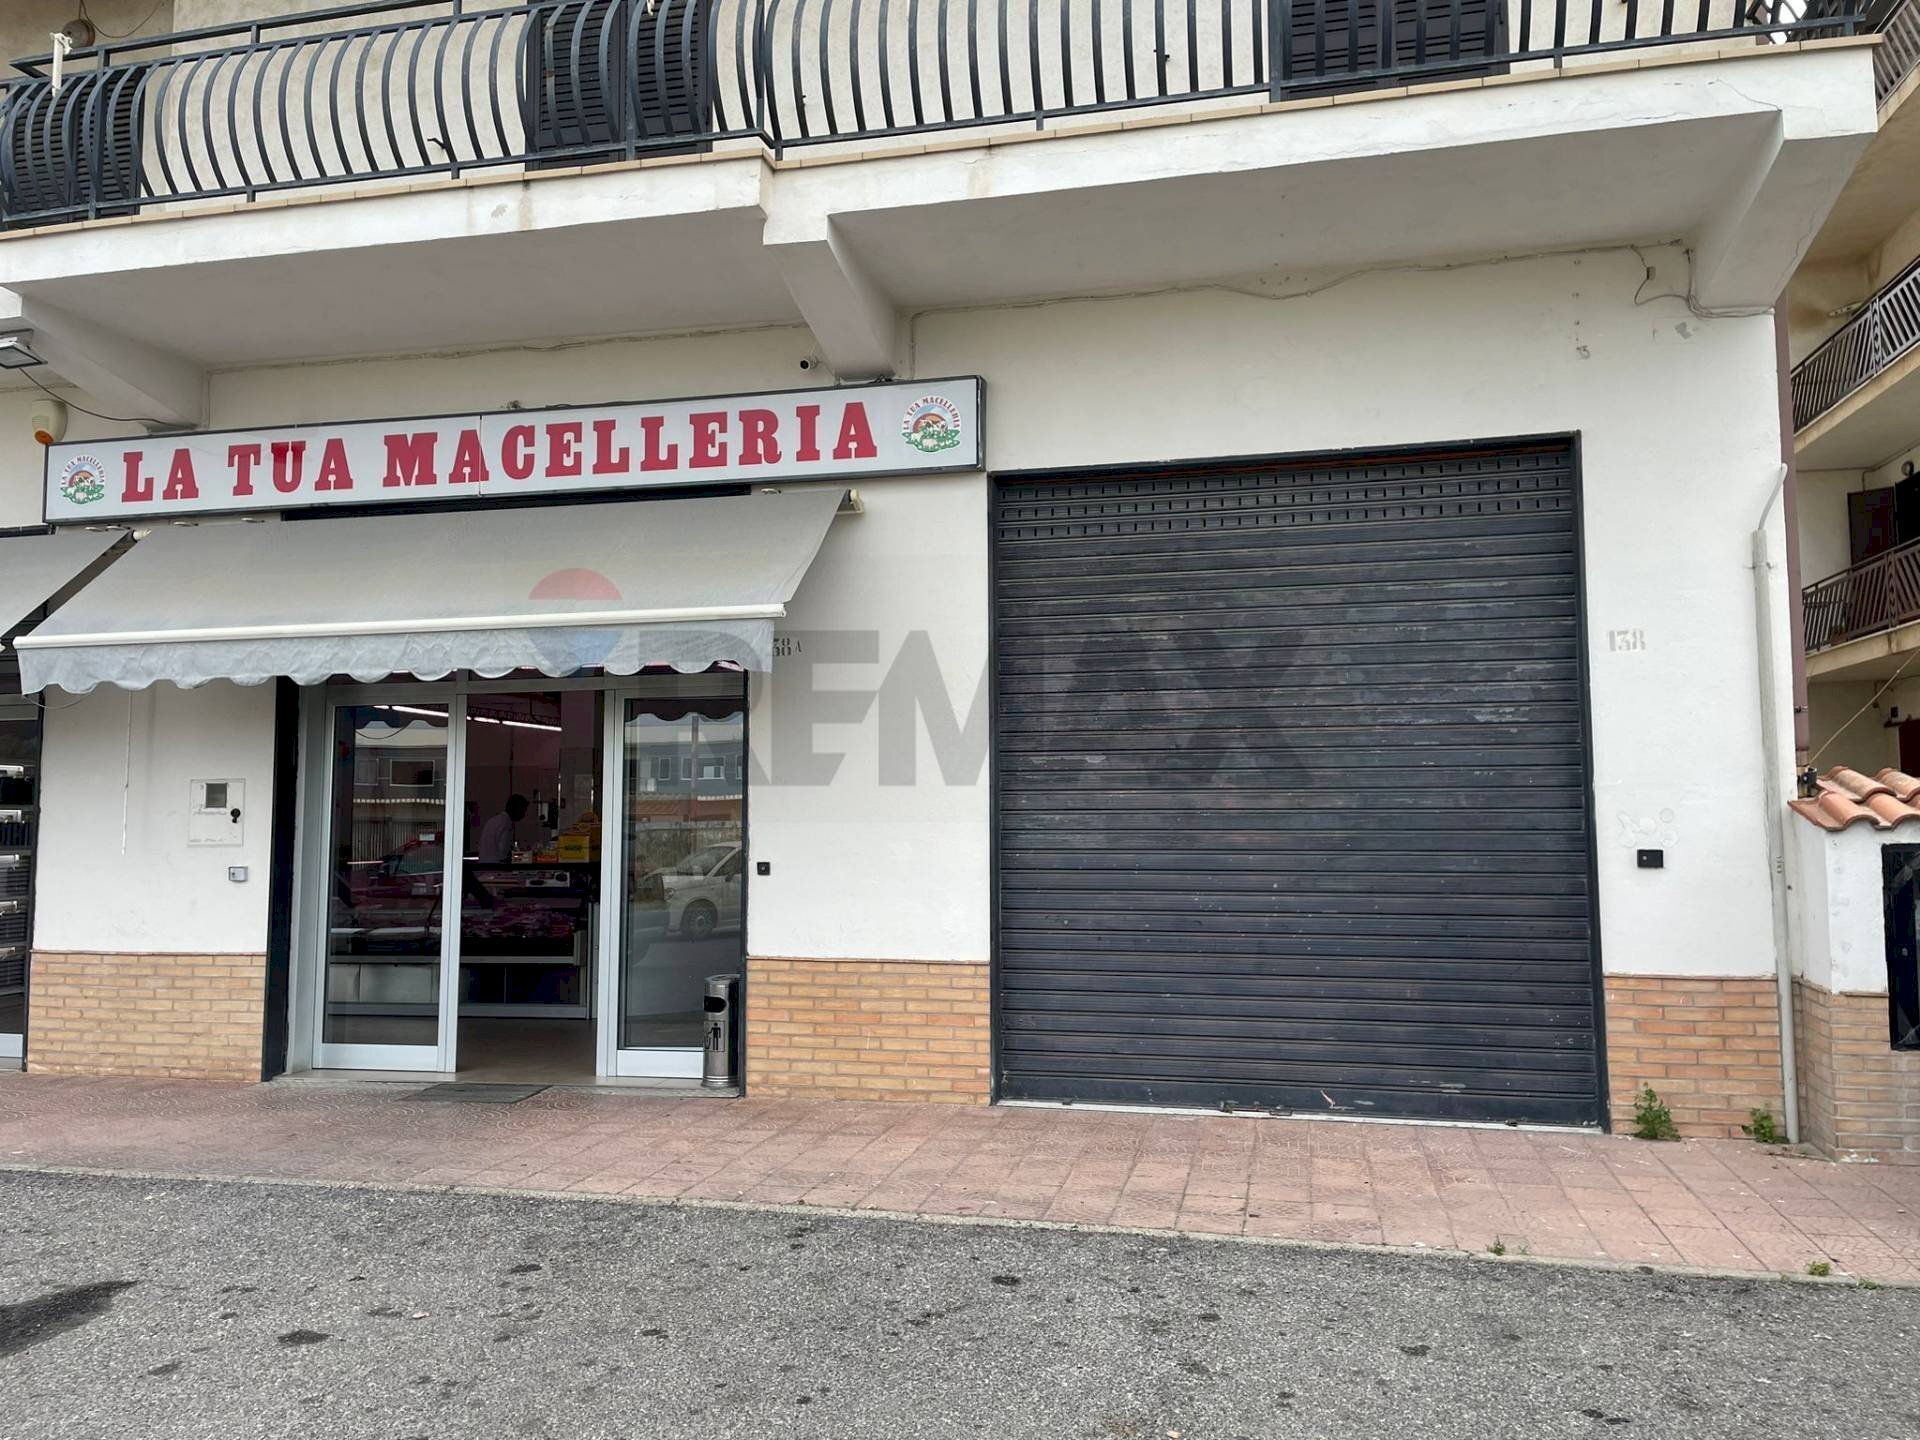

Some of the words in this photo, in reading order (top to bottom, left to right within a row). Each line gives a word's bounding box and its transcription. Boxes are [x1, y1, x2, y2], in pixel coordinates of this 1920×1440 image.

[122, 449, 200, 503] LA
[227, 439, 354, 497] TUA
[383, 402, 878, 488] MACELLERIA
[1608, 629, 1646, 652] 138
